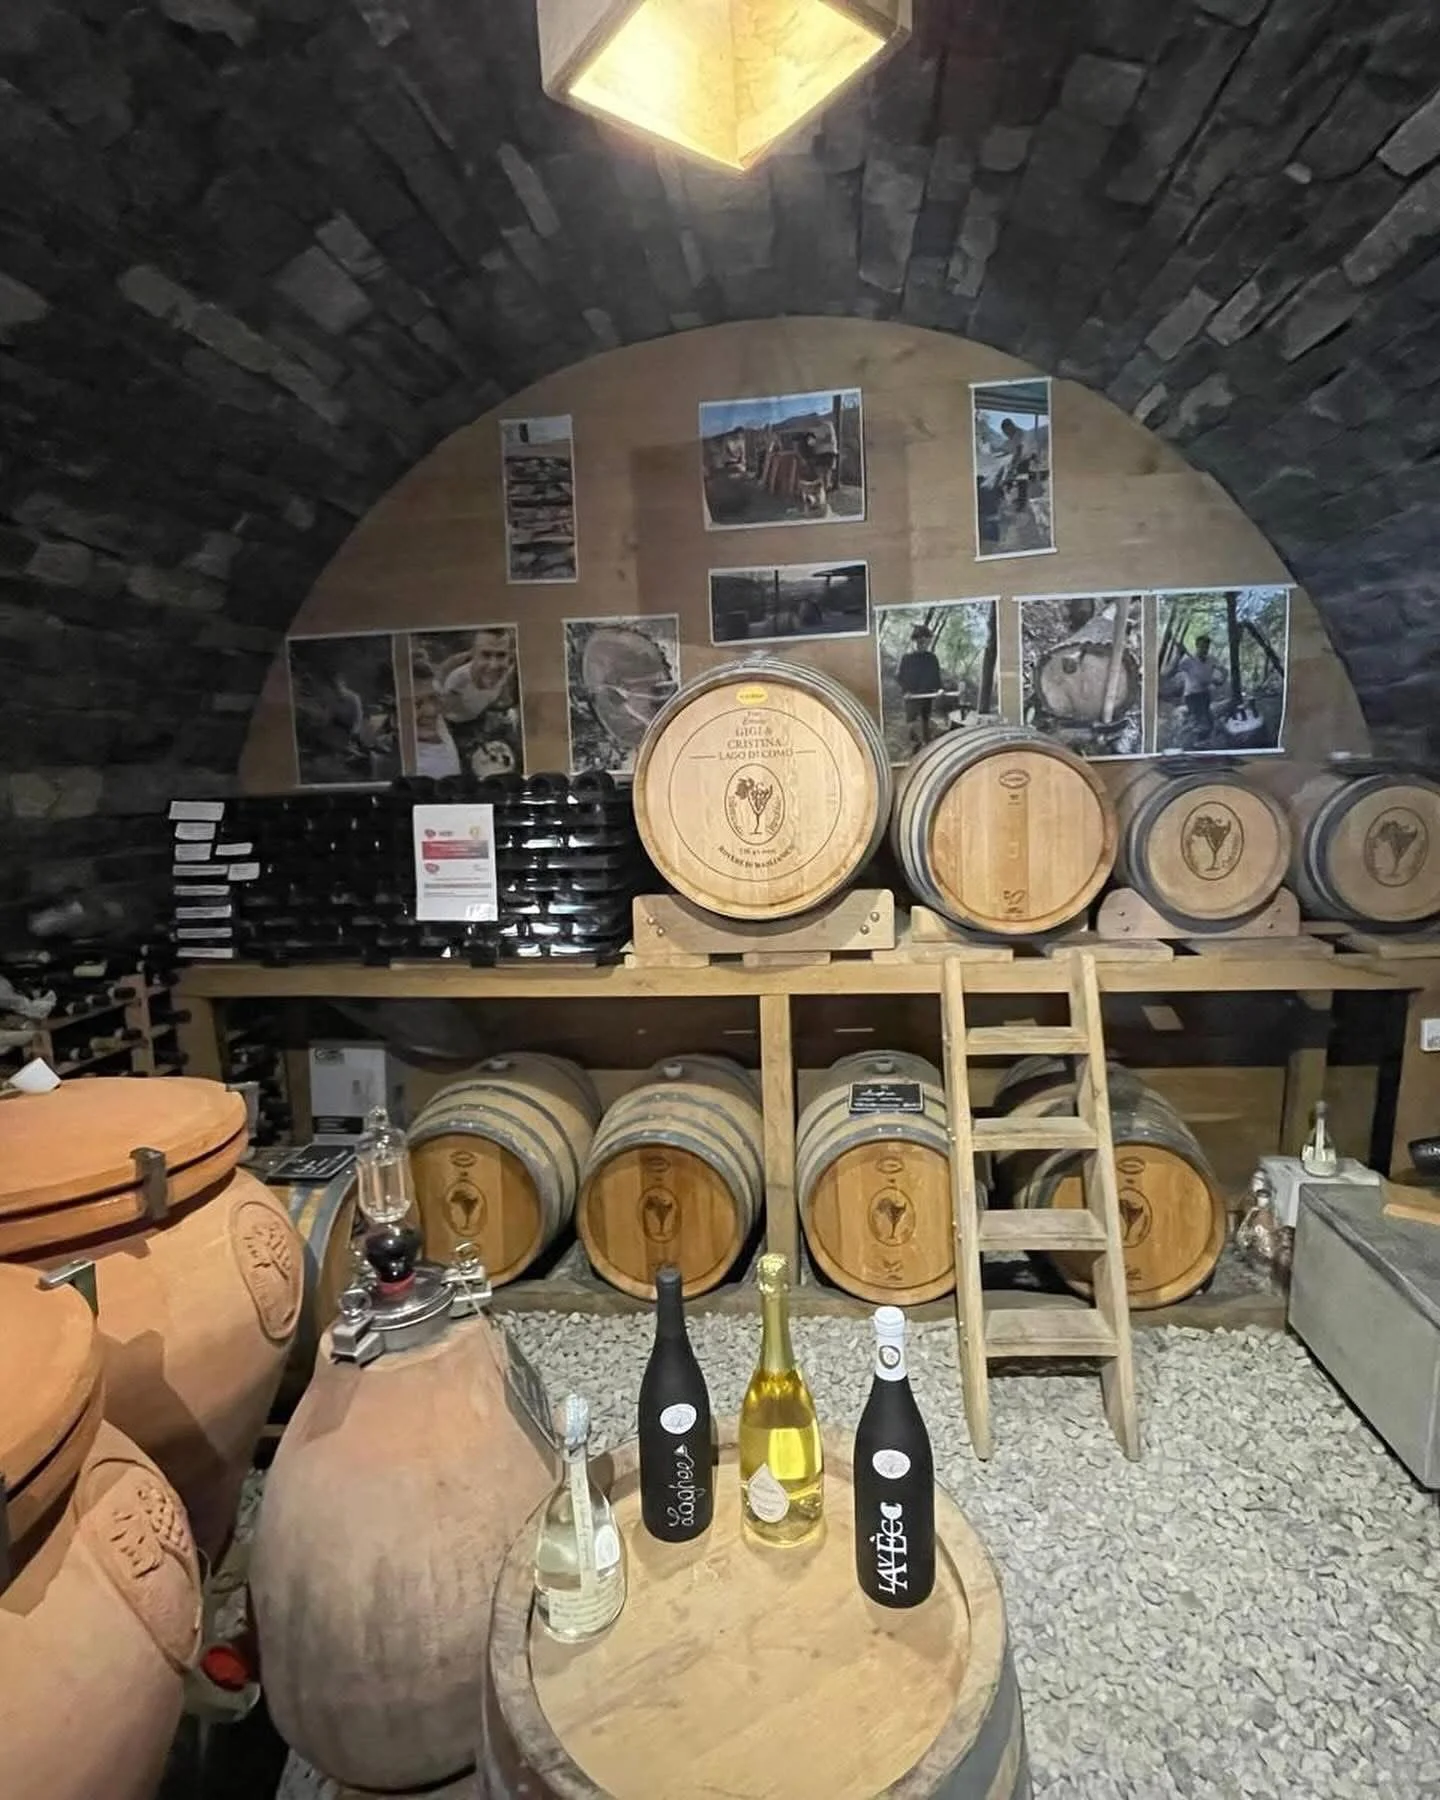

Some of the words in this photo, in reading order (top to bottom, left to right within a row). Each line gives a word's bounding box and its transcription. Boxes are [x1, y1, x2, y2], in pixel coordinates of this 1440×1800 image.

[727, 738, 782, 750] CRISTINA
[719, 751, 746, 761] LAGO
[748, 750, 760, 760] DI
[761, 747, 794, 758] COMO
